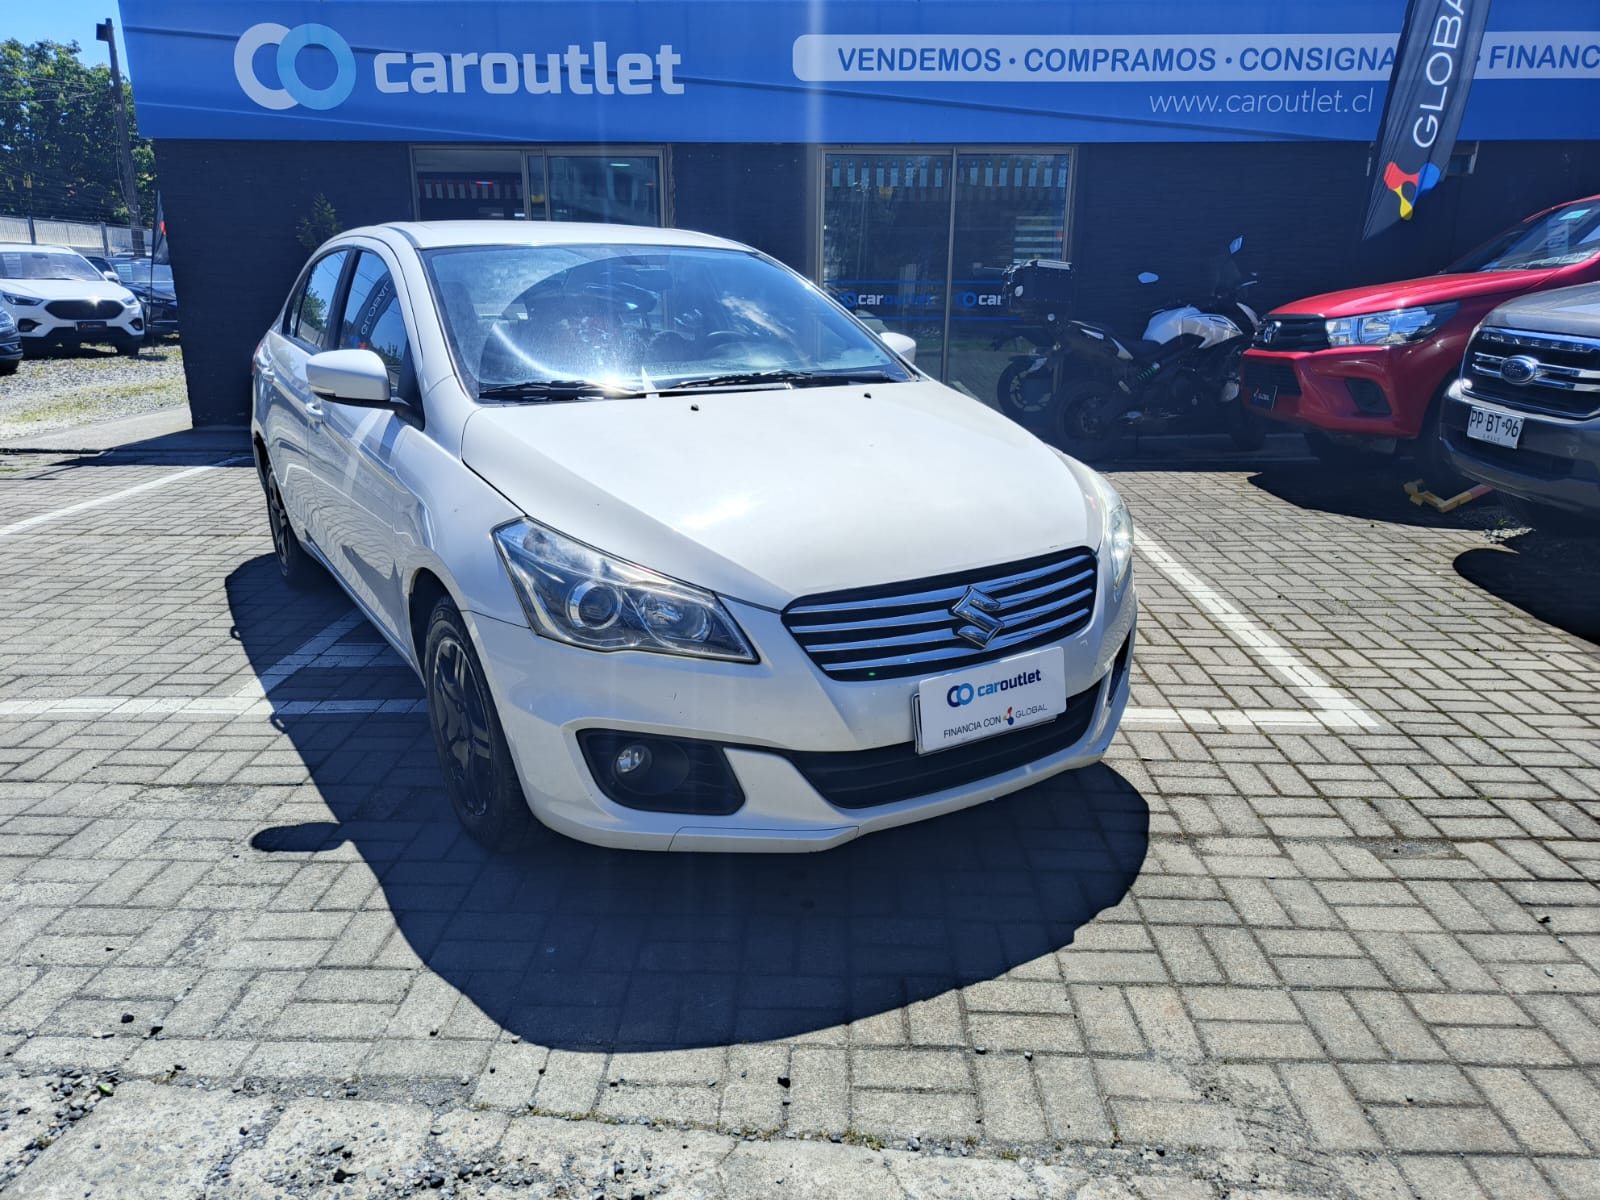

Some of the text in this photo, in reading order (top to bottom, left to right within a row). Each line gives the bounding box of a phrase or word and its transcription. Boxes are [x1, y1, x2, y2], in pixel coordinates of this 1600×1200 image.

[373, 41, 685, 95] caroutlet
[838, 47, 1001, 72] VENDEMOS
[1024, 47, 1216, 72] COMPRAMOS
[1489, 44, 1600, 69] FINANC
[1149, 87, 1373, 113] www.caroutlet.cl
[977, 669, 1042, 697] caroutlet
[943, 703, 1048, 739] FINANCIA CON GLOBAL
